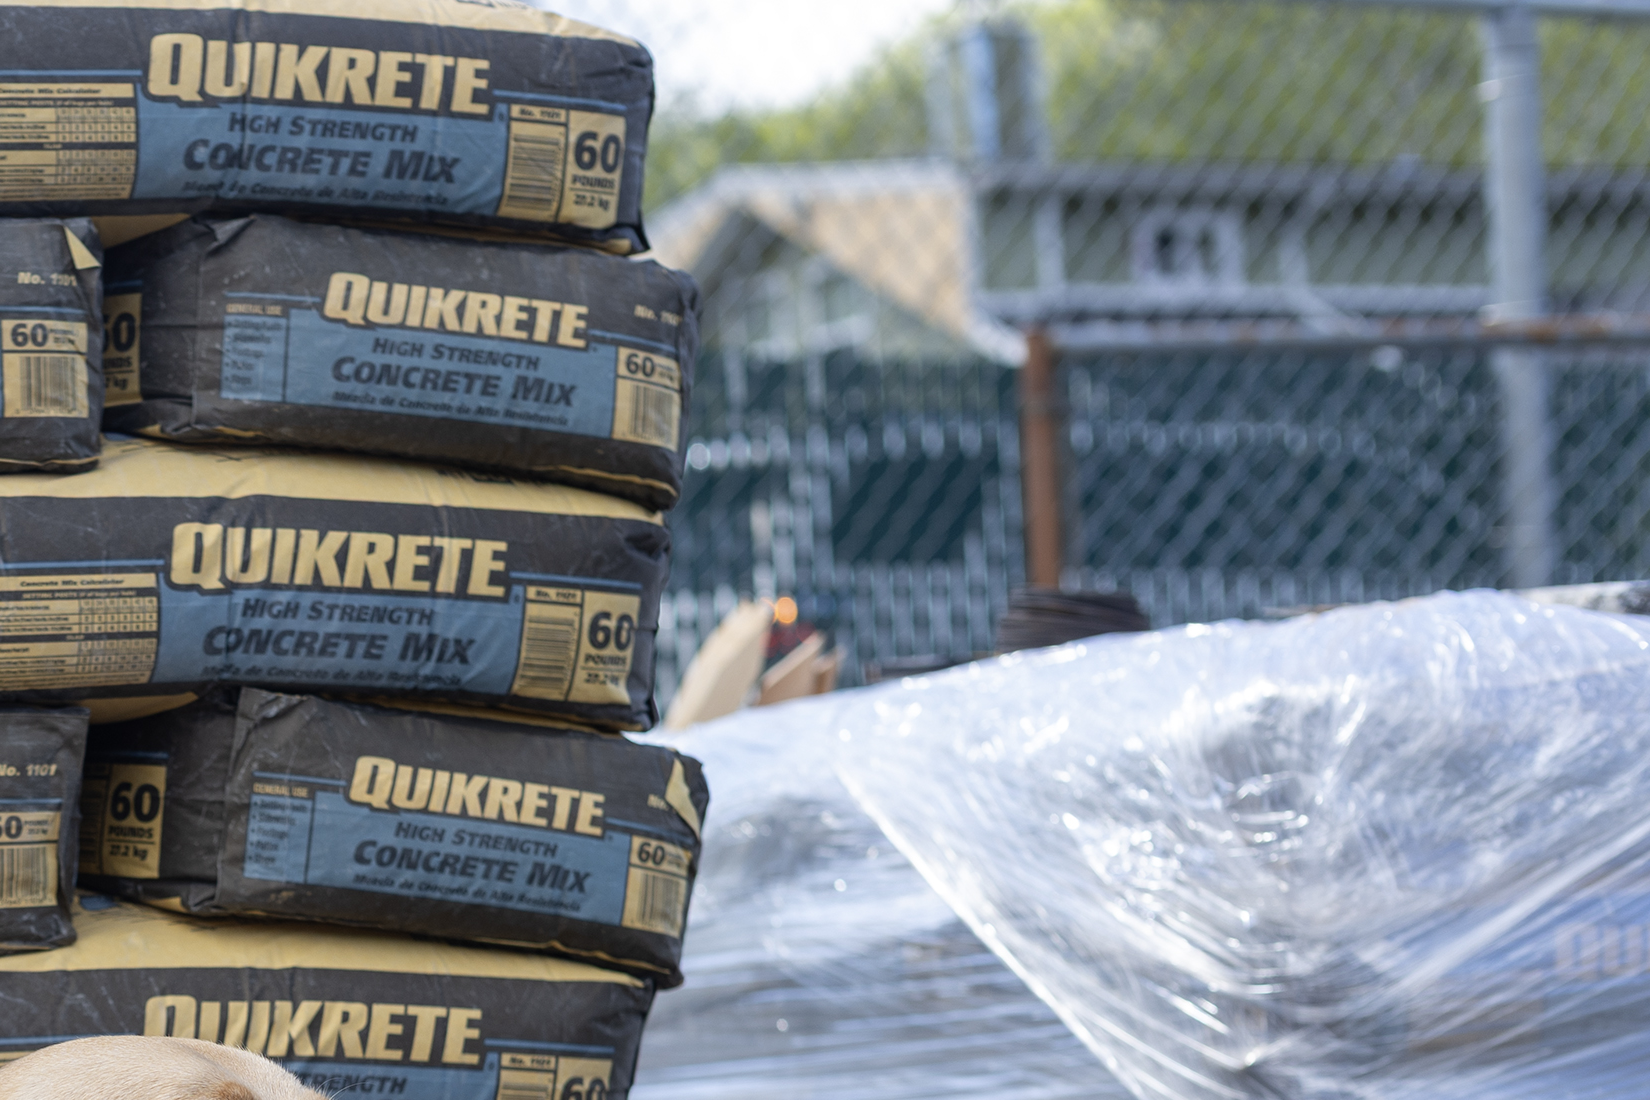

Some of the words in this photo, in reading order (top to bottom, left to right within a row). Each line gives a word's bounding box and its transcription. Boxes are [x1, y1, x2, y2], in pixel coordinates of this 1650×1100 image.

[147, 33, 490, 115] QUIKRETE
[289, 115, 417, 143] STRENGTH
[183, 138, 372, 178] CONCRETE
[383, 148, 462, 184] MIX
[574, 130, 621, 173] 60
[323, 272, 589, 348] QUIKRETE
[11, 323, 48, 347] 60
[372, 337, 425, 359] HIGH
[430, 343, 541, 372] STRENGTH
[332, 356, 502, 398] CONCRETE
[511, 374, 577, 408] MIX
[626, 353, 655, 378] 60
[170, 522, 508, 597] QUIKRETE
[242, 598, 299, 620] HIGH
[307, 601, 435, 627] STRENGTH
[589, 610, 633, 651] 60
[203, 625, 389, 661] CONCRETE
[399, 631, 476, 666] MIX
[109, 781, 160, 823] 60
[349, 755, 606, 837] QUIKRETE
[395, 820, 446, 843] HIGH
[452, 829, 559, 858] STRENGTH
[637, 841, 665, 866] 60
[353, 840, 519, 884] CONCRETE
[526, 861, 592, 894] MIX
